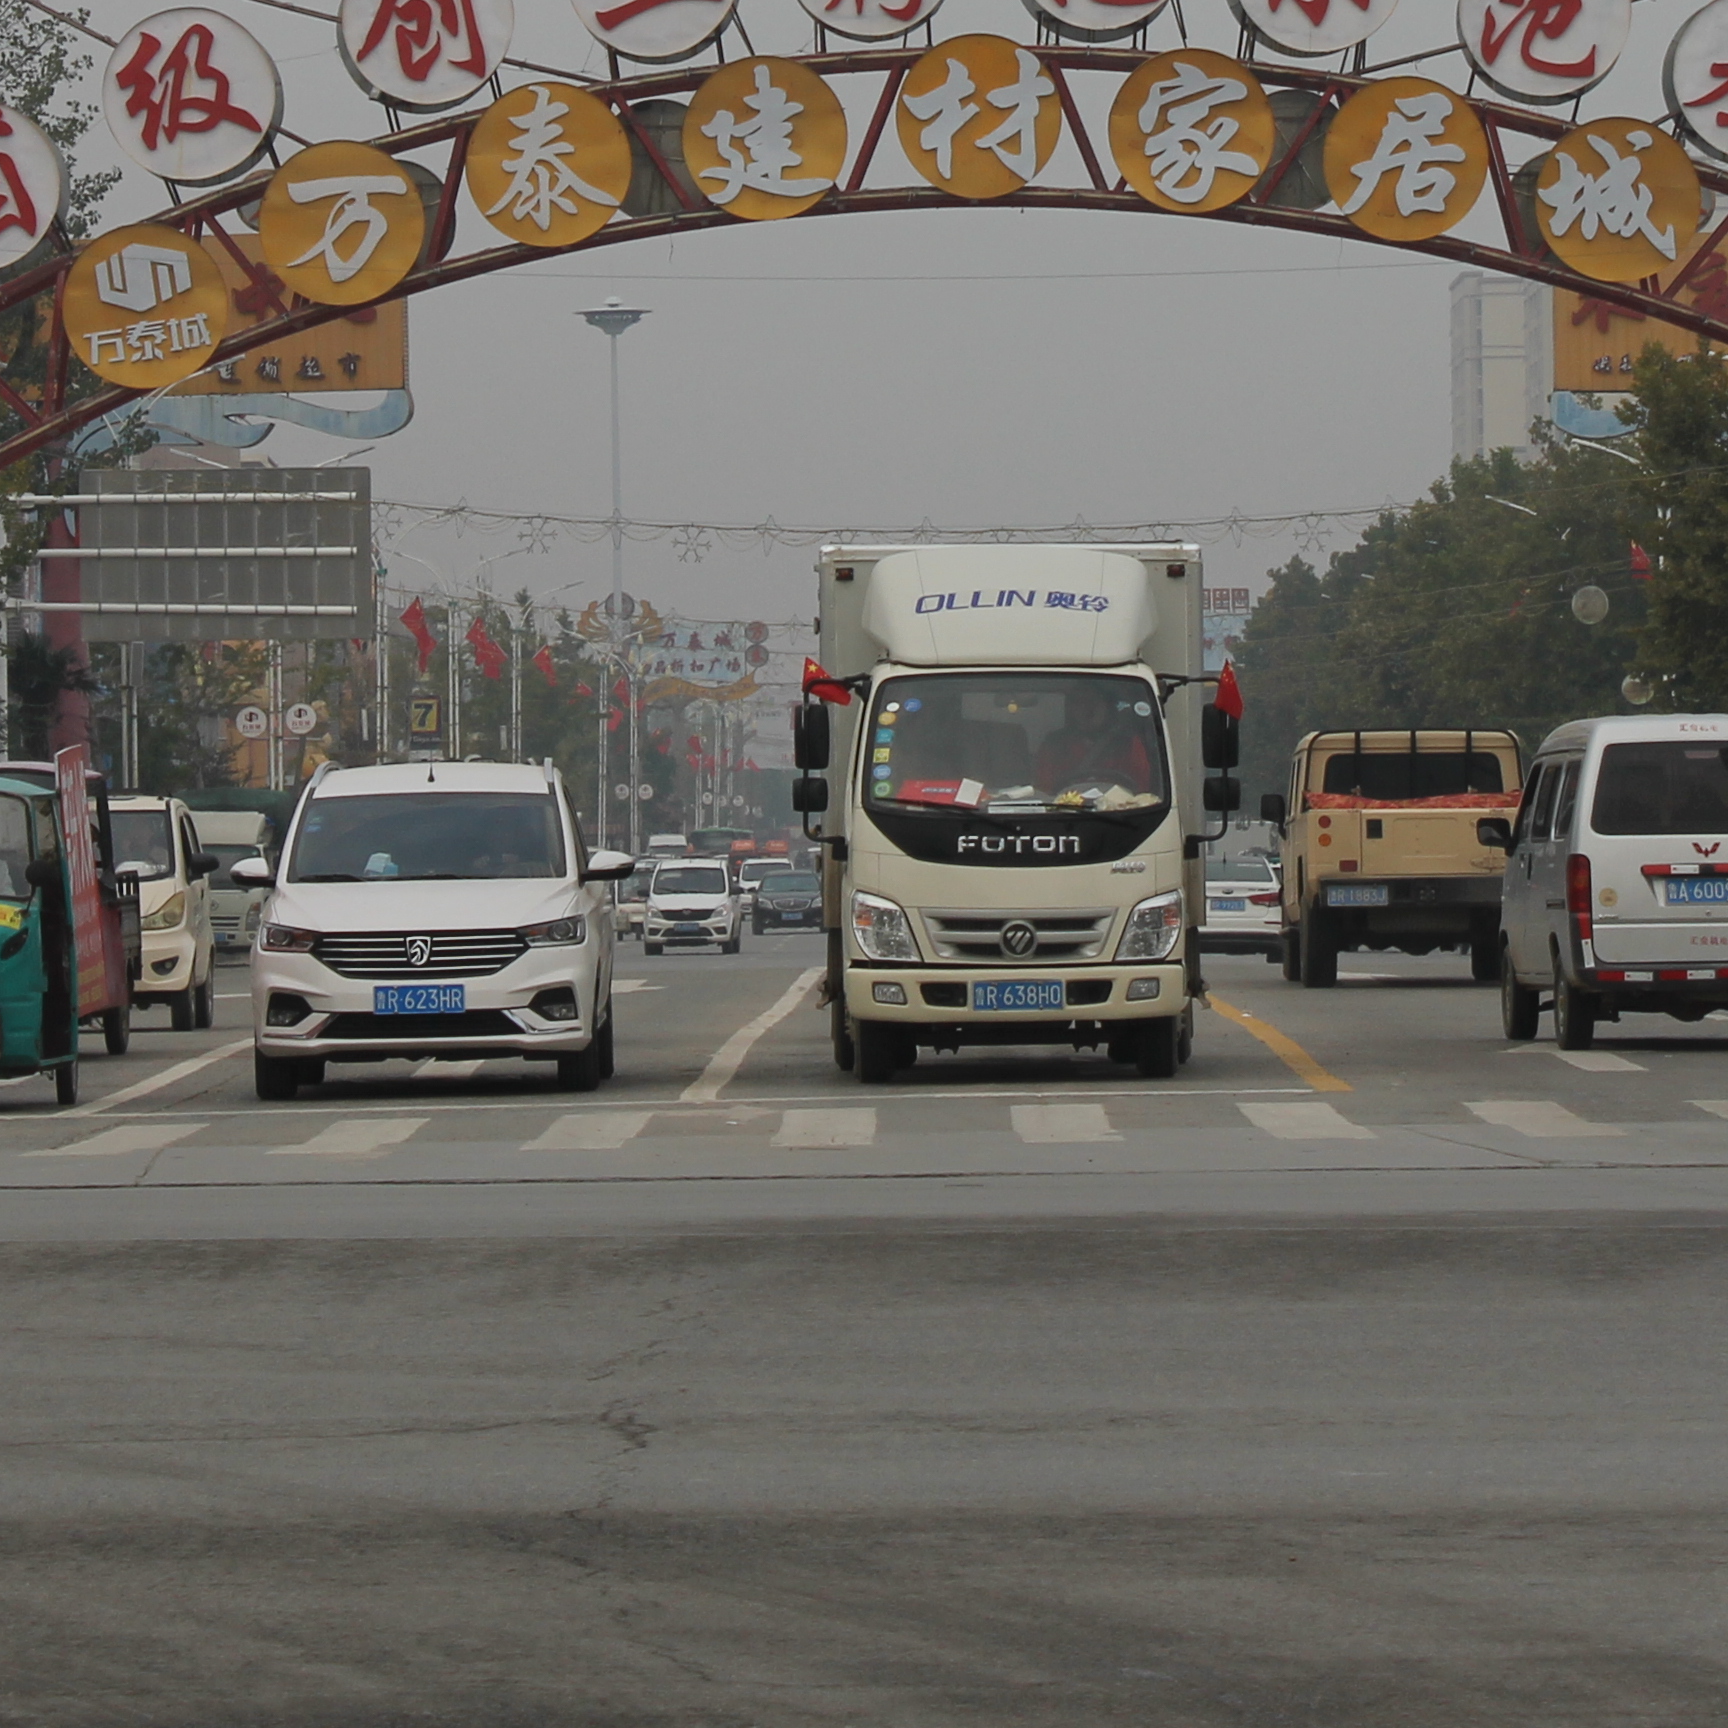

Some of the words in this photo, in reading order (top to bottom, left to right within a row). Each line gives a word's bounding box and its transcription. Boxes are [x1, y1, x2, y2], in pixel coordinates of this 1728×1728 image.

[83, 313, 213, 365] 万泰城
[915, 590, 1037, 614] OLLIN
[1043, 590, 1110, 613] 奥铃
[414, 703, 433, 728] 7
[957, 835, 1081, 854] FOTON
